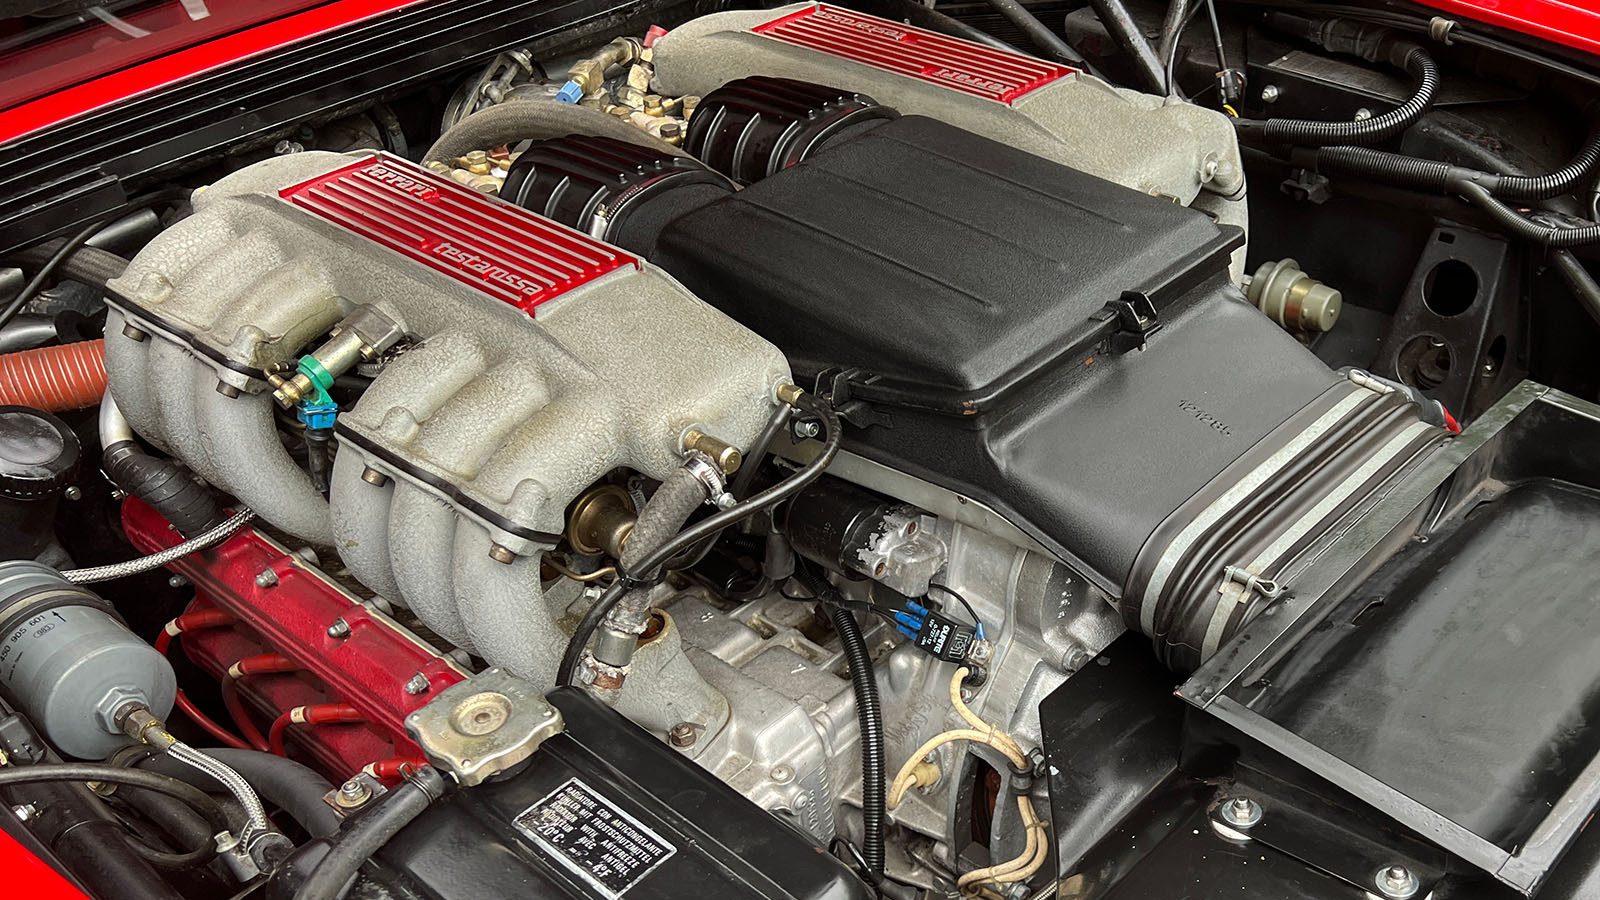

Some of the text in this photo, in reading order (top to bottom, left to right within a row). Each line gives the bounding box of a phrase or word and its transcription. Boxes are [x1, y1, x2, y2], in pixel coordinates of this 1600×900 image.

[10, 627, 27, 643] 905
[28, 614, 46, 627] 601
[933, 625, 950, 654] DURITE
[550, 802, 640, 869] RADIATOR WITH ANTIFREEZE
[565, 786, 664, 857] RADIATORE CON ANTICONGELANTE
[579, 808, 594, 820] MIT
[590, 817, 653, 864] FROSTSCHUTZMITTEL
[577, 836, 597, 850] AVEC
[601, 854, 631, 876] ANTIGEL
